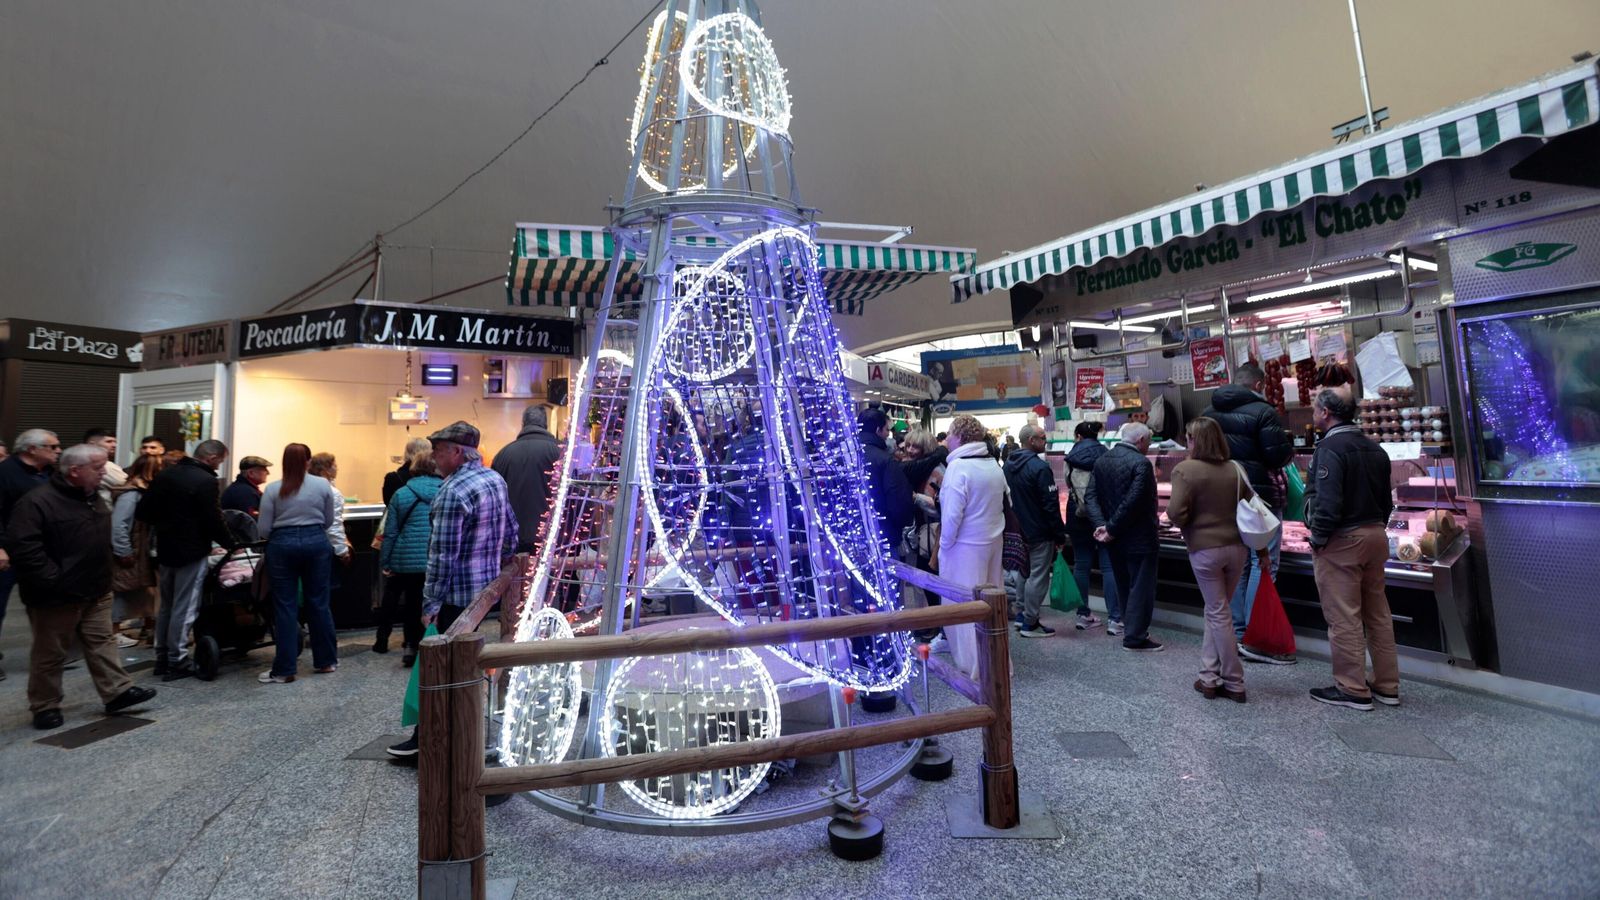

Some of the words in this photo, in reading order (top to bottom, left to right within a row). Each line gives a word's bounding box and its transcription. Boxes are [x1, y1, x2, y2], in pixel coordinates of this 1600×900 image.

[1495, 191, 1533, 209] 118
[1075, 252, 1162, 296] Fernando
[1166, 231, 1240, 274] García
[1515, 245, 1537, 259] FG
[35, 326, 65, 340] Bar
[244, 310, 347, 350] Pescadería
[456, 316, 550, 348] Martín
[26, 332, 57, 351] La
[63, 335, 119, 360] Plaza
